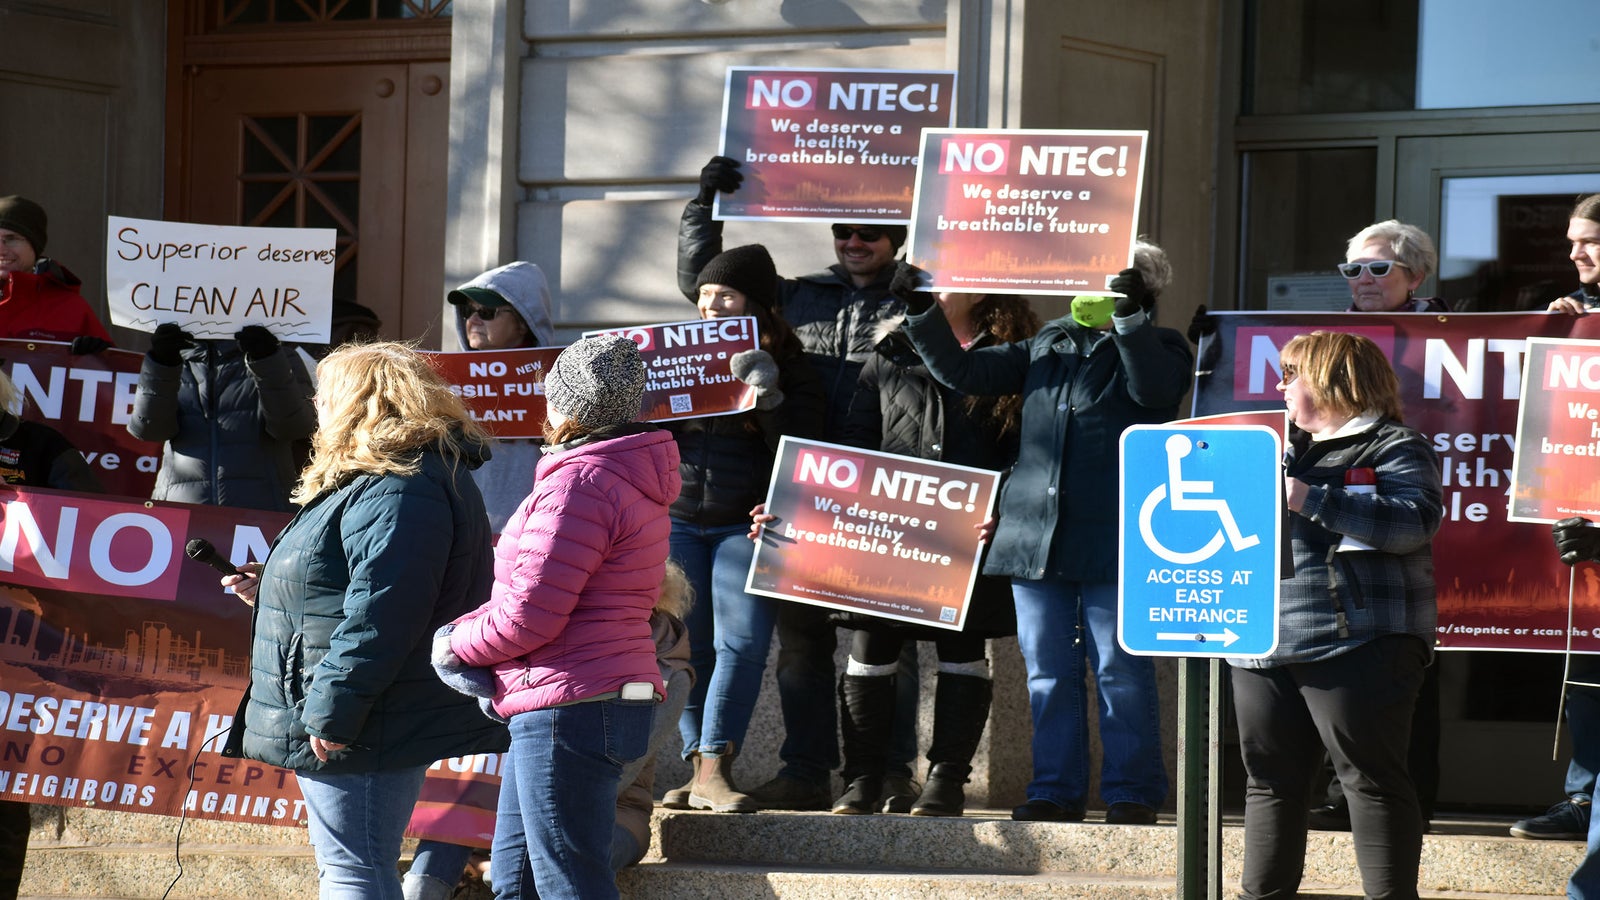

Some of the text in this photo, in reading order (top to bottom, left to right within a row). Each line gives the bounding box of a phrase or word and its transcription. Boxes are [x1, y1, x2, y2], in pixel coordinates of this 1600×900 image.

[751, 78, 940, 113] NO NTEC!
[770, 118, 902, 135] We deserve a
[794, 134, 870, 153] healthy
[746, 149, 919, 167] breathable future
[944, 141, 1128, 177] NO NTEC!
[963, 184, 1090, 200] We deserve a
[985, 199, 1059, 218] healthy
[937, 215, 1110, 234] breathable future
[117, 227, 337, 272] Superior deserves
[131, 283, 306, 317] CLEAN AIR
[603, 319, 750, 350] O NTEC!
[469, 360, 543, 378] NO NEW
[651, 353, 713, 368] deserve
[717, 351, 727, 361] a
[648, 365, 706, 380] healthy
[1549, 354, 1600, 390] NO
[1568, 402, 1598, 419] We
[136, 455, 158, 473] a
[799, 453, 980, 513] NO NTEC!
[814, 496, 938, 531] We deserve a
[833, 516, 904, 544] healthy
[0, 500, 174, 587] NO
[784, 523, 952, 566] breathable future
[1146, 568, 1253, 585] ACCESS AT
[1175, 589, 1223, 604] EAST
[1149, 607, 1248, 624] ENTRANCE
[1435, 624, 1510, 636] e/stopntec
[0, 691, 155, 746] ESERVE
[161, 710, 192, 750] A
[4, 741, 295, 789] NO EXCEPT
[0, 770, 306, 820] NEIGHBORS AGAINST
